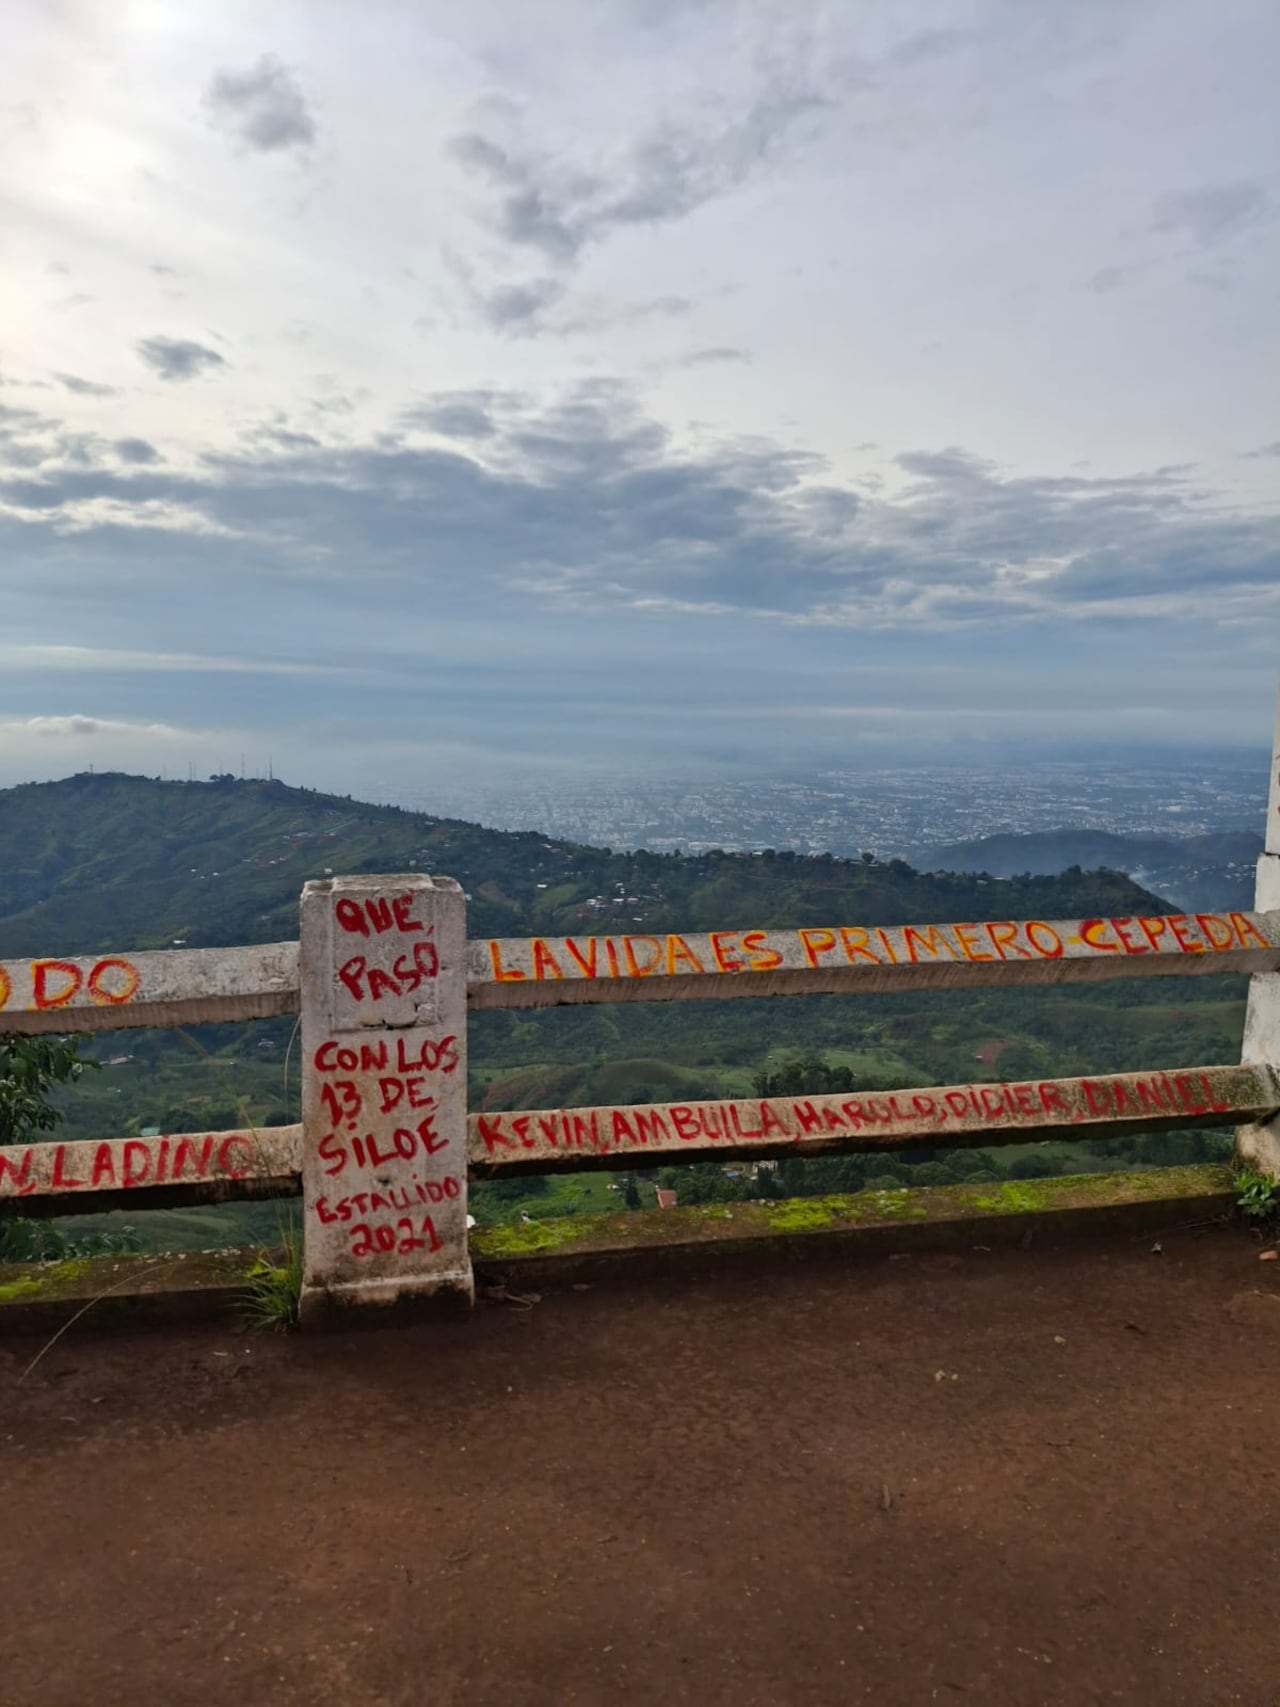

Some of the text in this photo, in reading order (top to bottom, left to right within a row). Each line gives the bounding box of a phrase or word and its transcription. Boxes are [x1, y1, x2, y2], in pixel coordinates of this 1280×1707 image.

[709, 930, 783, 973] ES
[315, 1035, 459, 1073] CON LOS
[321, 1077, 434, 1129] 13 DE
[1081, 1071, 1232, 1118] DANIEL
[52, 1135, 256, 1189] LADINO
[349, 1216, 443, 1257] 2021
